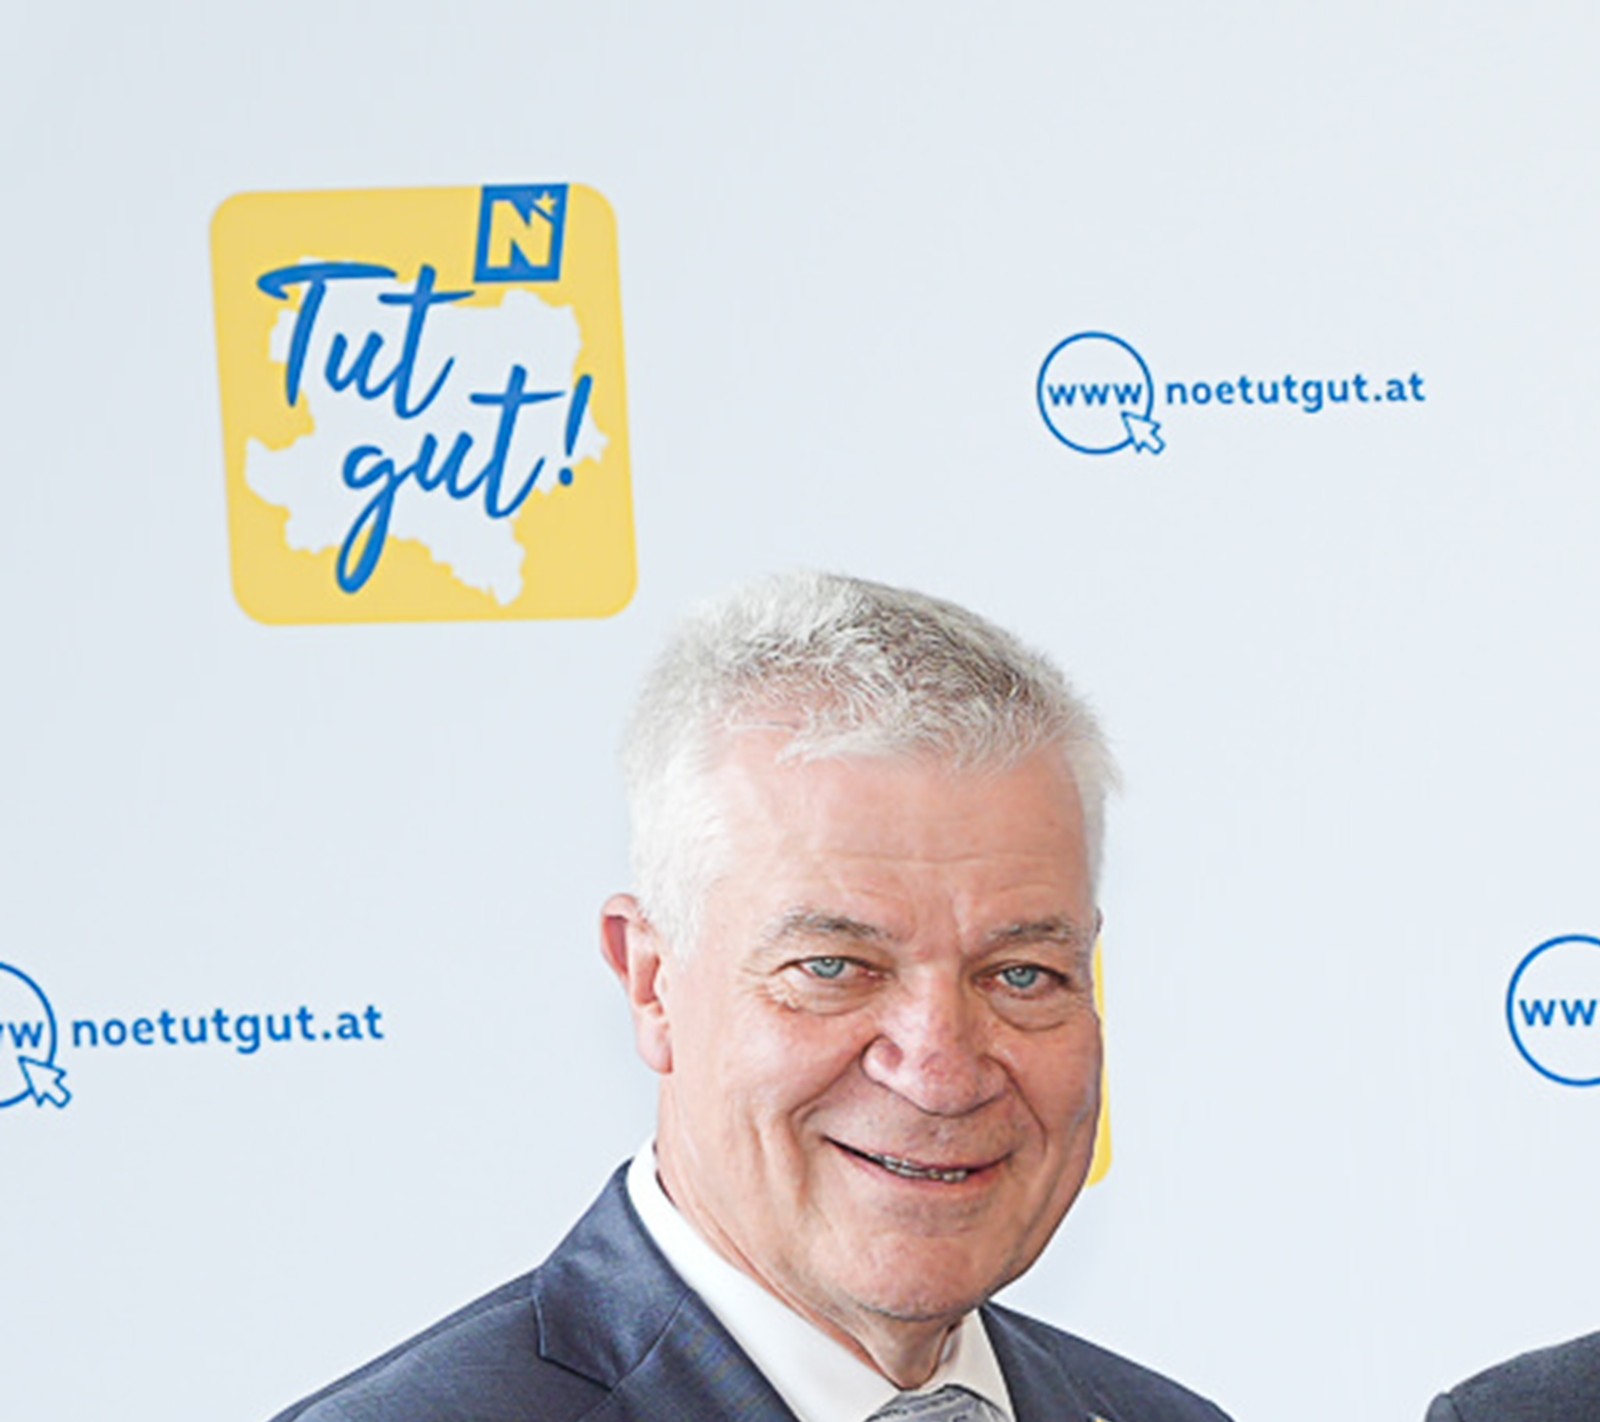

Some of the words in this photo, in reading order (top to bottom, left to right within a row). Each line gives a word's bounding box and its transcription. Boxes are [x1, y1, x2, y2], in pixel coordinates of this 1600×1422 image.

[258, 262, 472, 421] Tut
[1047, 383, 1143, 407] www
[1166, 373, 1426, 414] noetutgut.at
[337, 364, 593, 593] gut!
[72, 1005, 385, 1056] noetutgut.at
